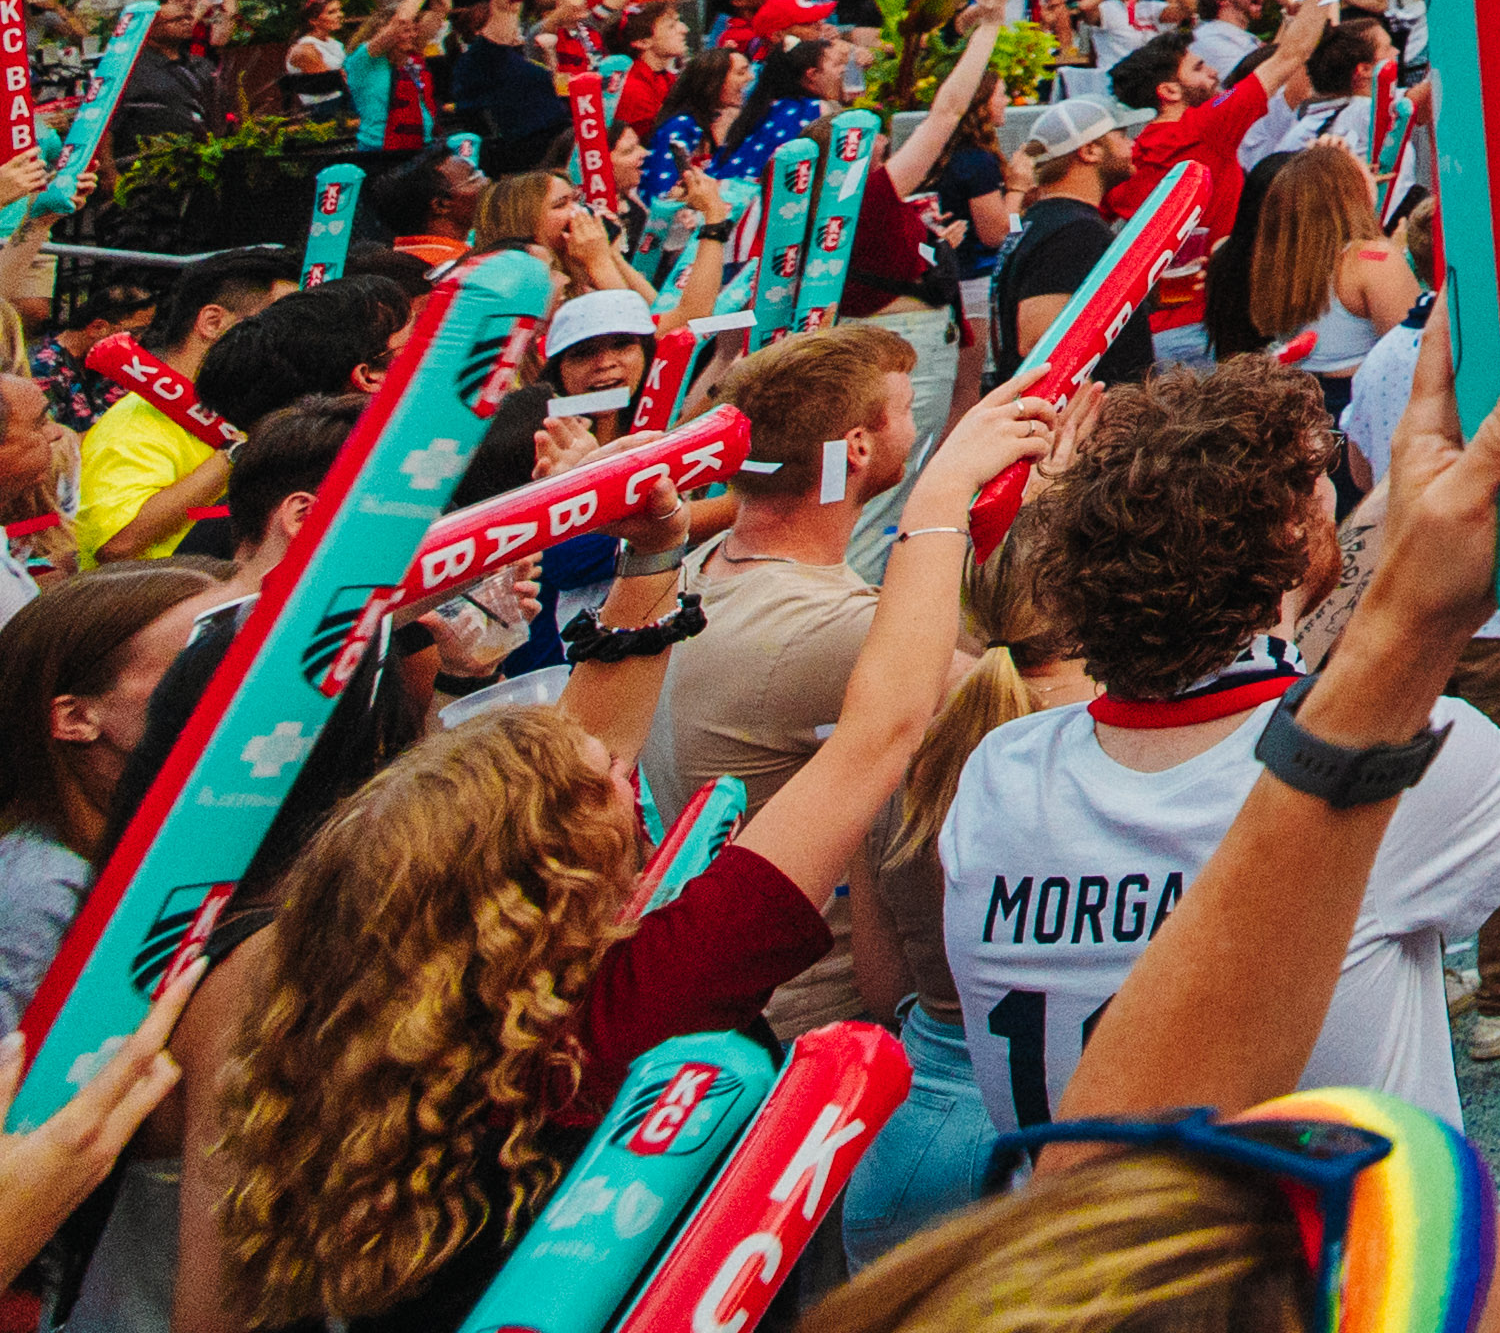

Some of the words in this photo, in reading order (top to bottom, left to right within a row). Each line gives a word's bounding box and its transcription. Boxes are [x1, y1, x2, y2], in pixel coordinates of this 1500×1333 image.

[576, 94, 599, 140] KC
[325, 184, 341, 215] KC
[825, 216, 843, 250] KC
[121, 355, 184, 402] KC
[634, 358, 669, 428] KC
[624, 439, 726, 508] KC
[408, 488, 599, 593] BAB
[987, 990, 1113, 1129] 1
[640, 1067, 711, 1144] KC
[692, 1103, 867, 1333] KC
